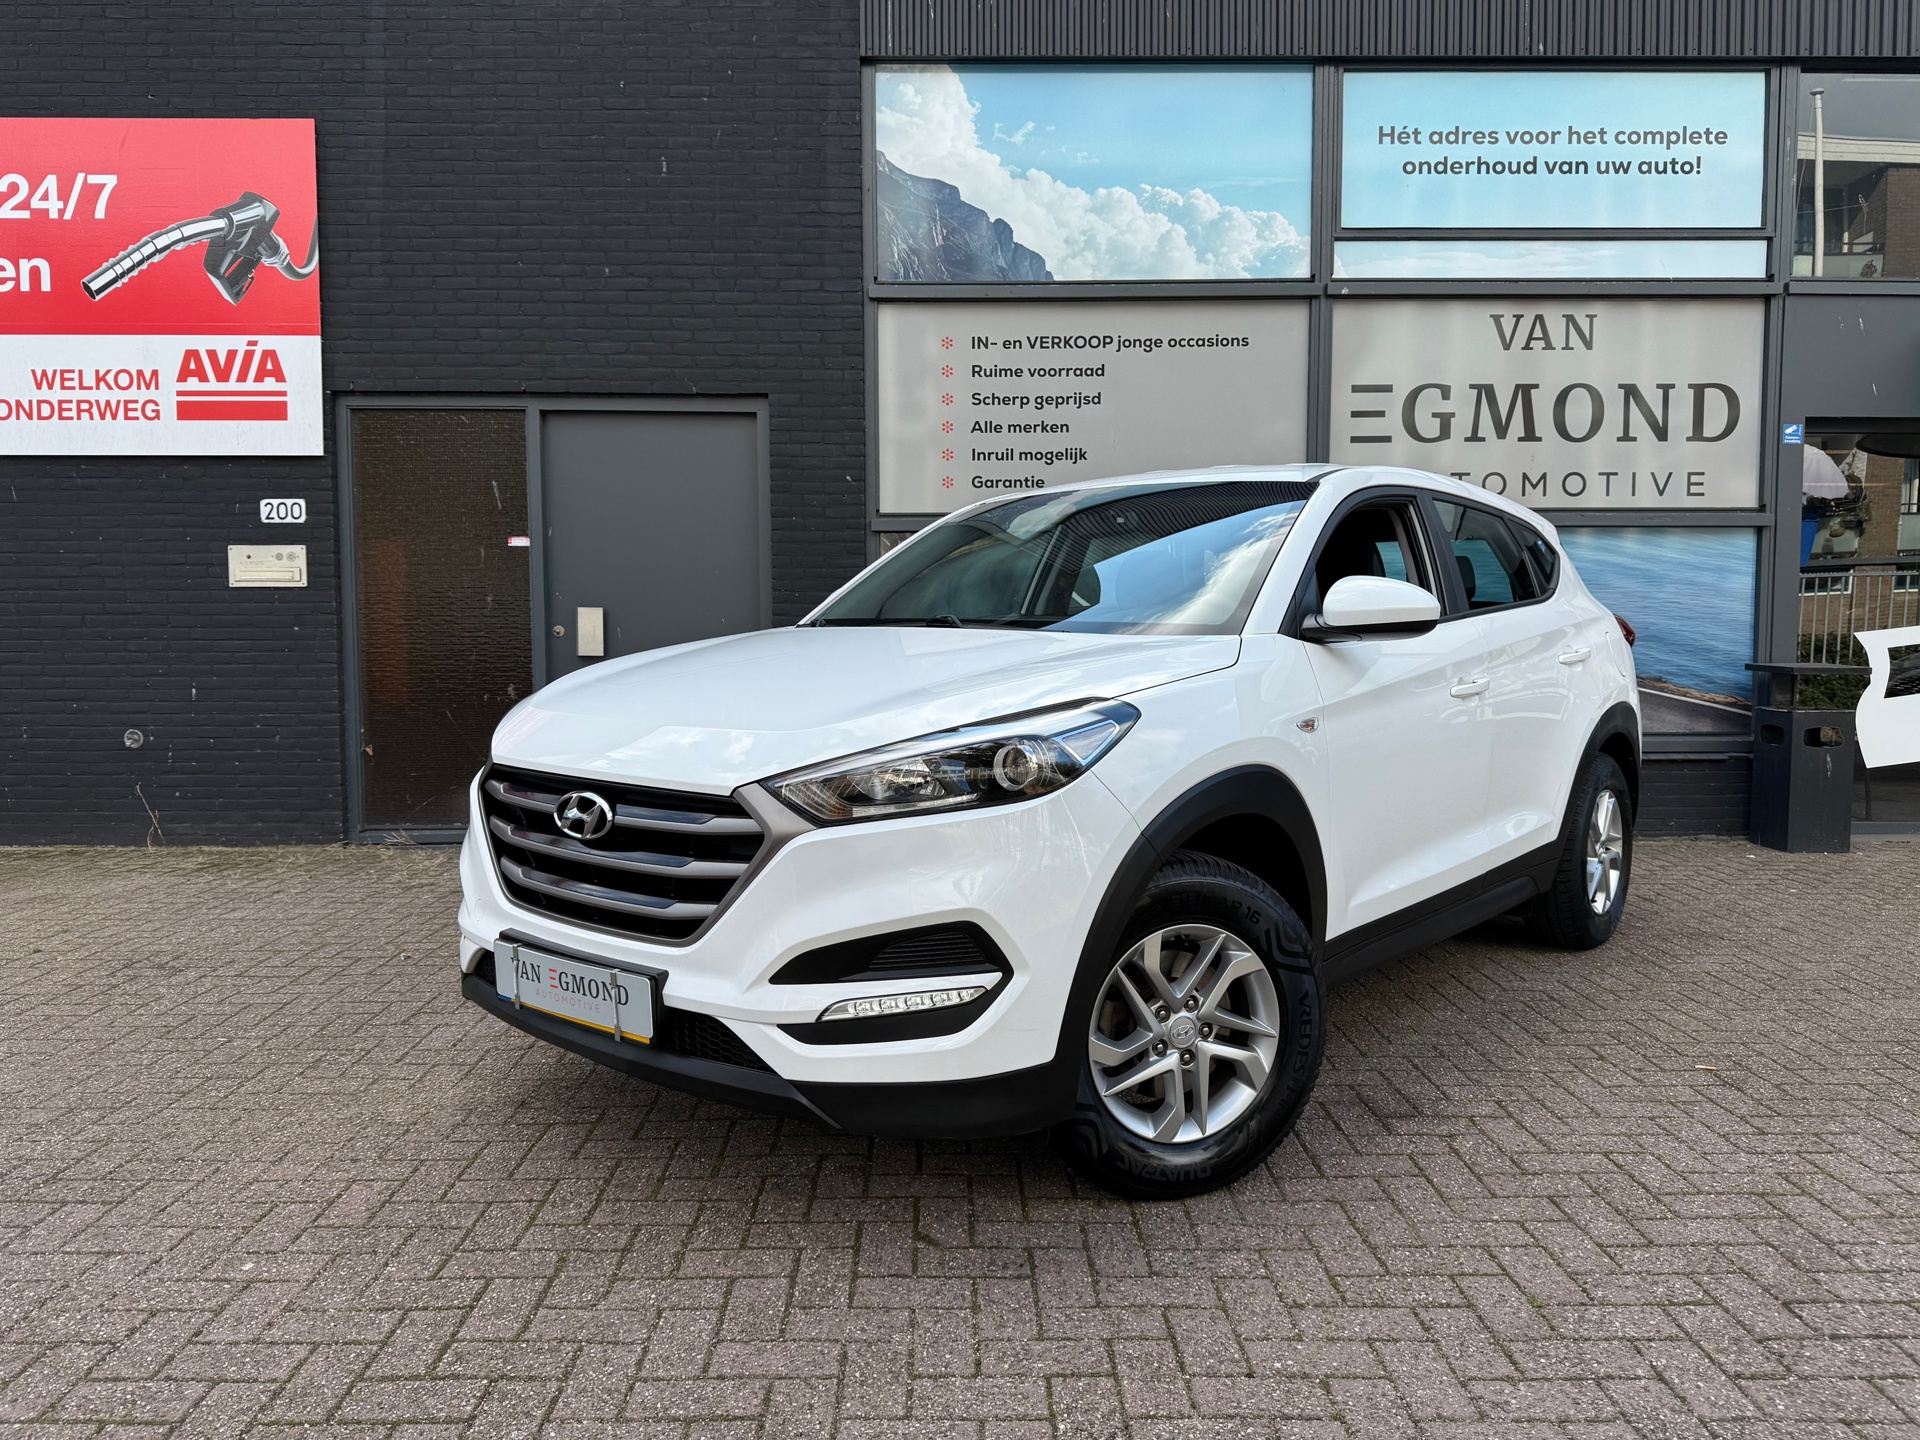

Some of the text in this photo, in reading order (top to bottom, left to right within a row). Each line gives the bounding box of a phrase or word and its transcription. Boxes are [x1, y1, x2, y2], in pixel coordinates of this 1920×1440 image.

[1379, 125, 1729, 151] Hét adres voor het complete
[1402, 155, 1703, 175] onderhoud van uw auto!
[0, 172, 118, 220] 24/7
[1489, 313, 1598, 351] VAN
[971, 333, 1250, 353] IN- en VERKOOP jonge occasions
[30, 368, 160, 391] WELKOM
[971, 363, 1105, 379] Ruime voorraad
[0, 398, 161, 421] ONDERWEG
[971, 391, 1102, 411] Scherp geprijsd
[1349, 382, 1741, 444] EGMOND
[970, 420, 1070, 434] Alle merken
[971, 447, 1088, 467] Inruil mogelijk
[971, 475, 1045, 490] Garantie
[1449, 471, 1706, 498] TOMOTIVE
[264, 502, 303, 520] 200
[535, 987, 601, 1014] AUTOMOTIVE
